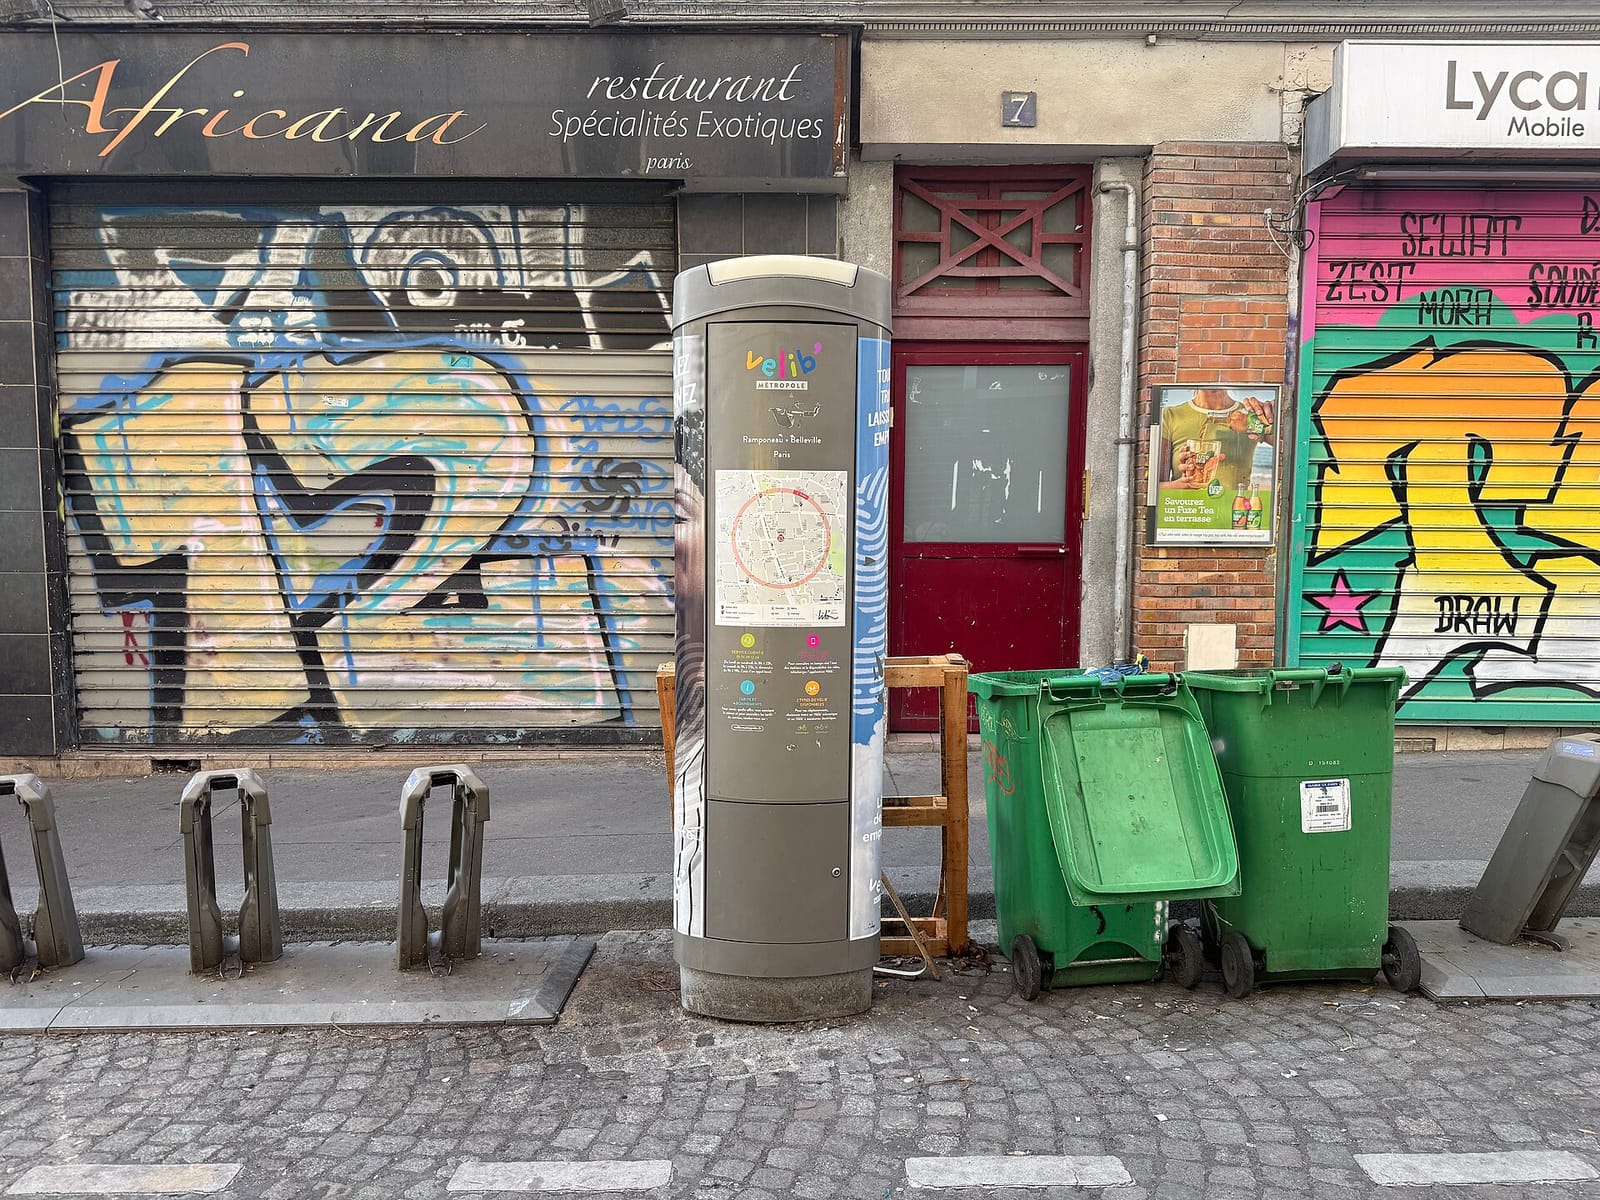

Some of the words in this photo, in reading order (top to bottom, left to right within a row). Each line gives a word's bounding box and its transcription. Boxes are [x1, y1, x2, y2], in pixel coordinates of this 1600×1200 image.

[0, 42, 488, 157] Africana
[587, 62, 802, 102] restaurant
[1446, 60, 1588, 120] Lyca
[549, 109, 689, 143] Spécialités
[696, 110, 823, 145] Exotiques
[1010, 96, 1028, 122] 7
[1507, 116, 1585, 137] Mobile
[645, 153, 693, 174] paris
[1326, 262, 1416, 301] ZEST
[742, 435, 784, 446] Ramponeau
[790, 435, 822, 444] Belleville
[773, 450, 791, 458] Paris
[1434, 595, 1520, 636] DRAW
